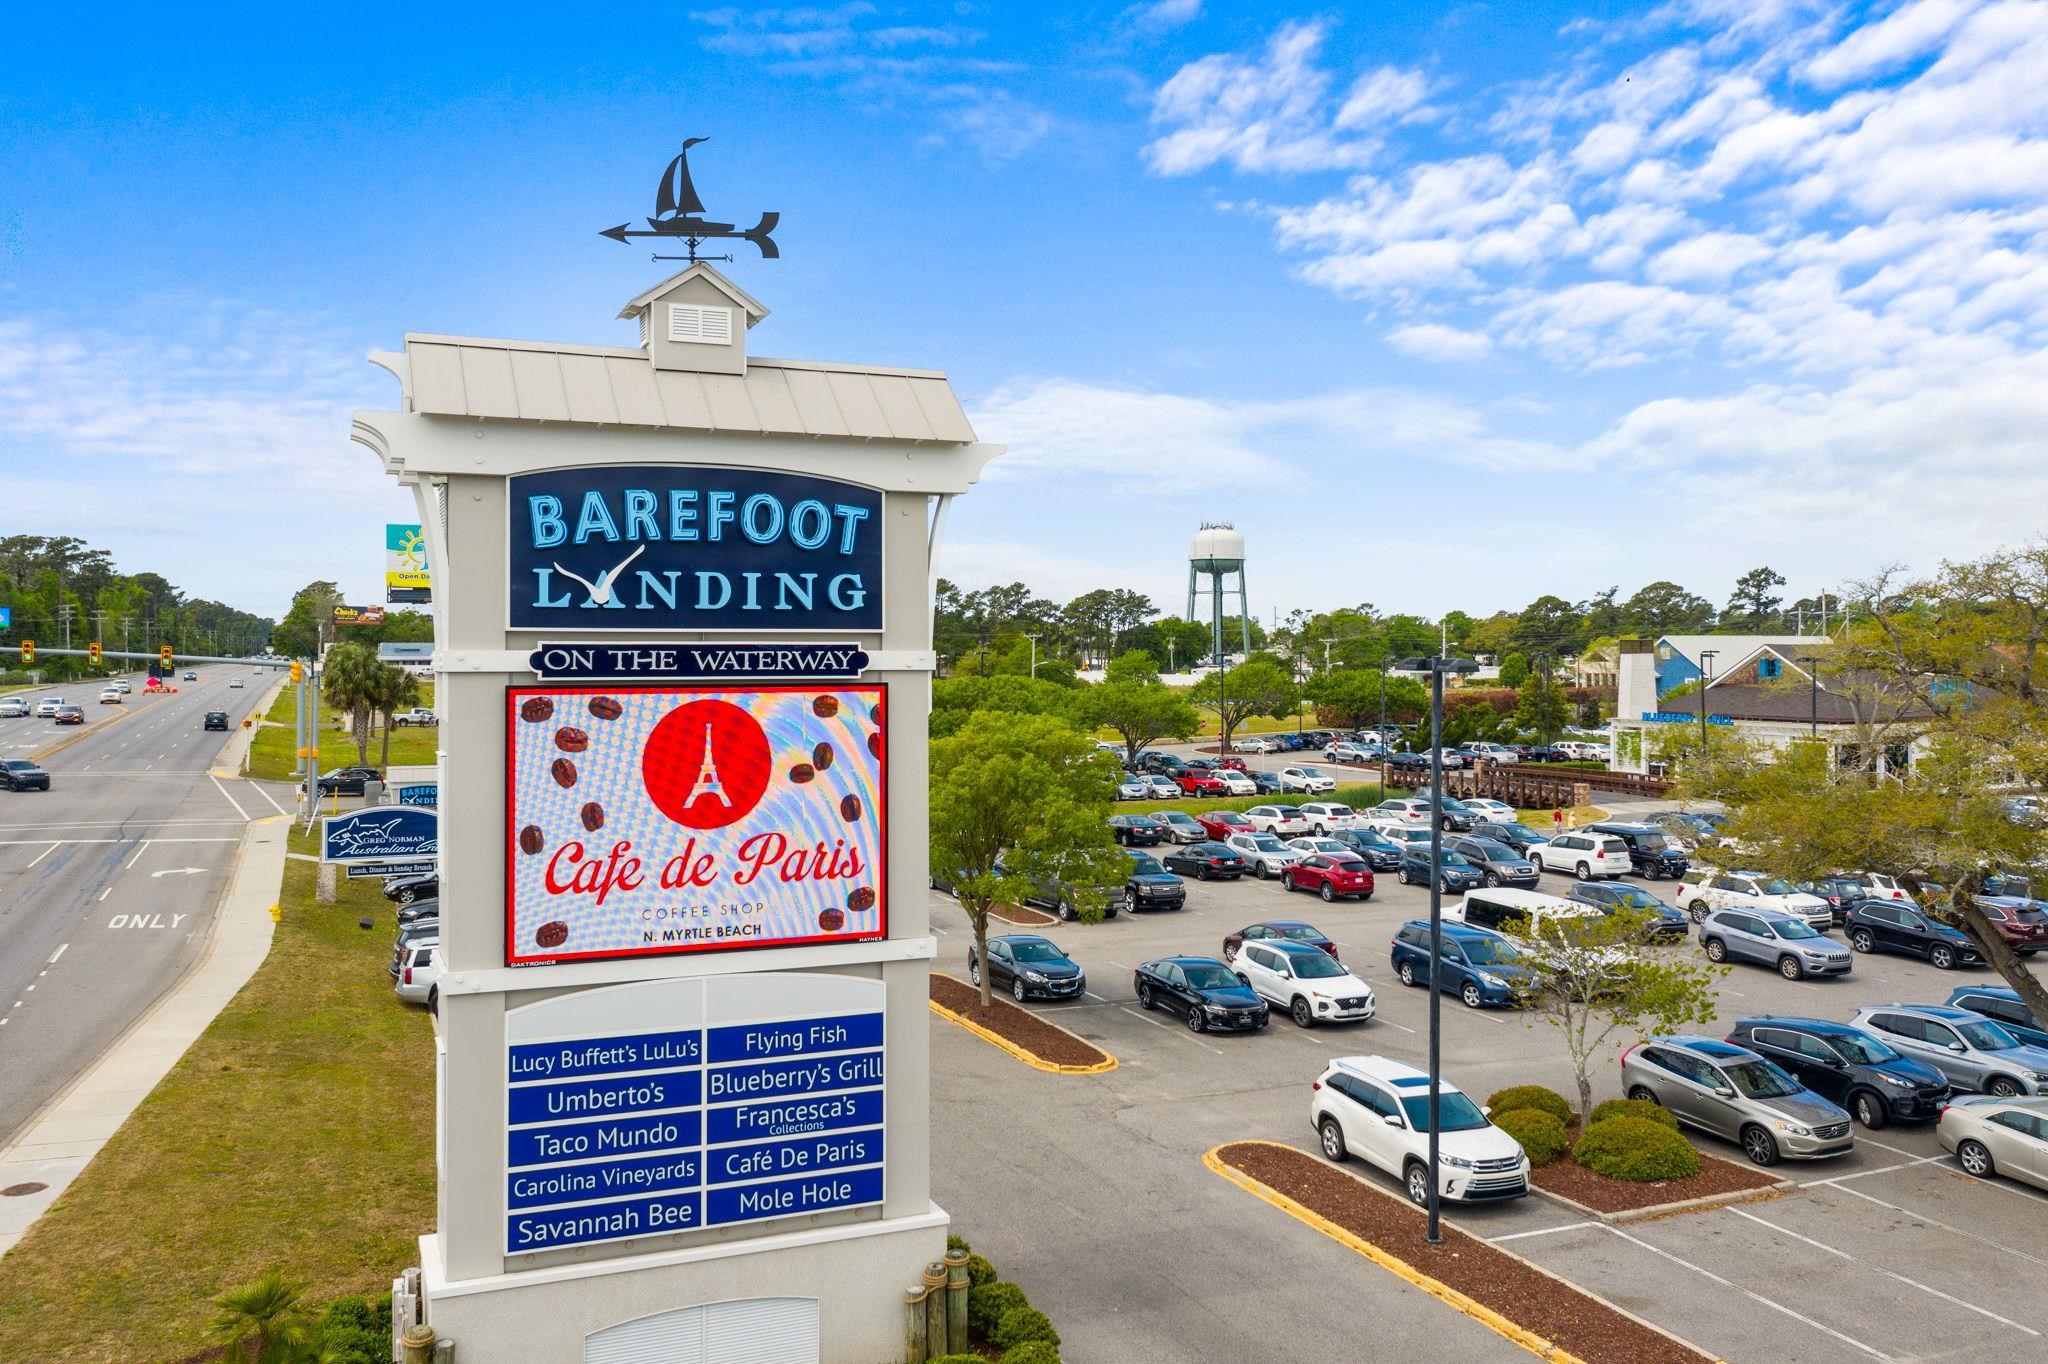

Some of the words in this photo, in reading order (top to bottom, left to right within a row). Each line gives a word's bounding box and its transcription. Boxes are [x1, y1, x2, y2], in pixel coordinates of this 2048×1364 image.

[528, 488, 869, 555] BAREFOOT
[532, 568, 866, 610] LANDING
[544, 649, 595, 670] ON
[608, 650, 678, 671] THE
[691, 650, 856, 671] WATERWAY
[1641, 711, 1696, 723] BLUEBERRY
[335, 843, 414, 856] Australian
[545, 841, 644, 905] Cafe
[661, 838, 717, 889] de
[734, 832, 865, 885] Paris
[108, 914, 187, 929] ONLY
[642, 905, 709, 921] COFFEE
[720, 902, 764, 916] SHOP
[643, 931, 657, 942] N.
[662, 927, 712, 941] MYRTLE
[717, 924, 761, 938] BEACH
[746, 1031, 803, 1054] Flying
[810, 1025, 847, 1045] Fish
[512, 1054, 555, 1074] Lucy
[561, 1044, 637, 1069] Buffett’s
[643, 1039, 699, 1061] LuLu’s
[711, 1063, 831, 1096] Blueberry’s
[838, 1056, 883, 1082] Grill
[547, 1081, 665, 1114] Umberto’s
[736, 1096, 856, 1128] Francesca’s
[535, 1133, 589, 1157] Taco
[598, 1122, 678, 1150] Mundo
[769, 1120, 825, 1135] Collections
[726, 1149, 773, 1176] Café
[781, 1146, 808, 1168] De
[816, 1139, 866, 1164] Paris
[514, 1172, 596, 1198] Carolina
[602, 1159, 695, 1188] Vineyards
[740, 1187, 793, 1214] Mole
[802, 1181, 852, 1205] Hole
[519, 1208, 639, 1243] Savannah
[649, 1203, 692, 1227] Bee
